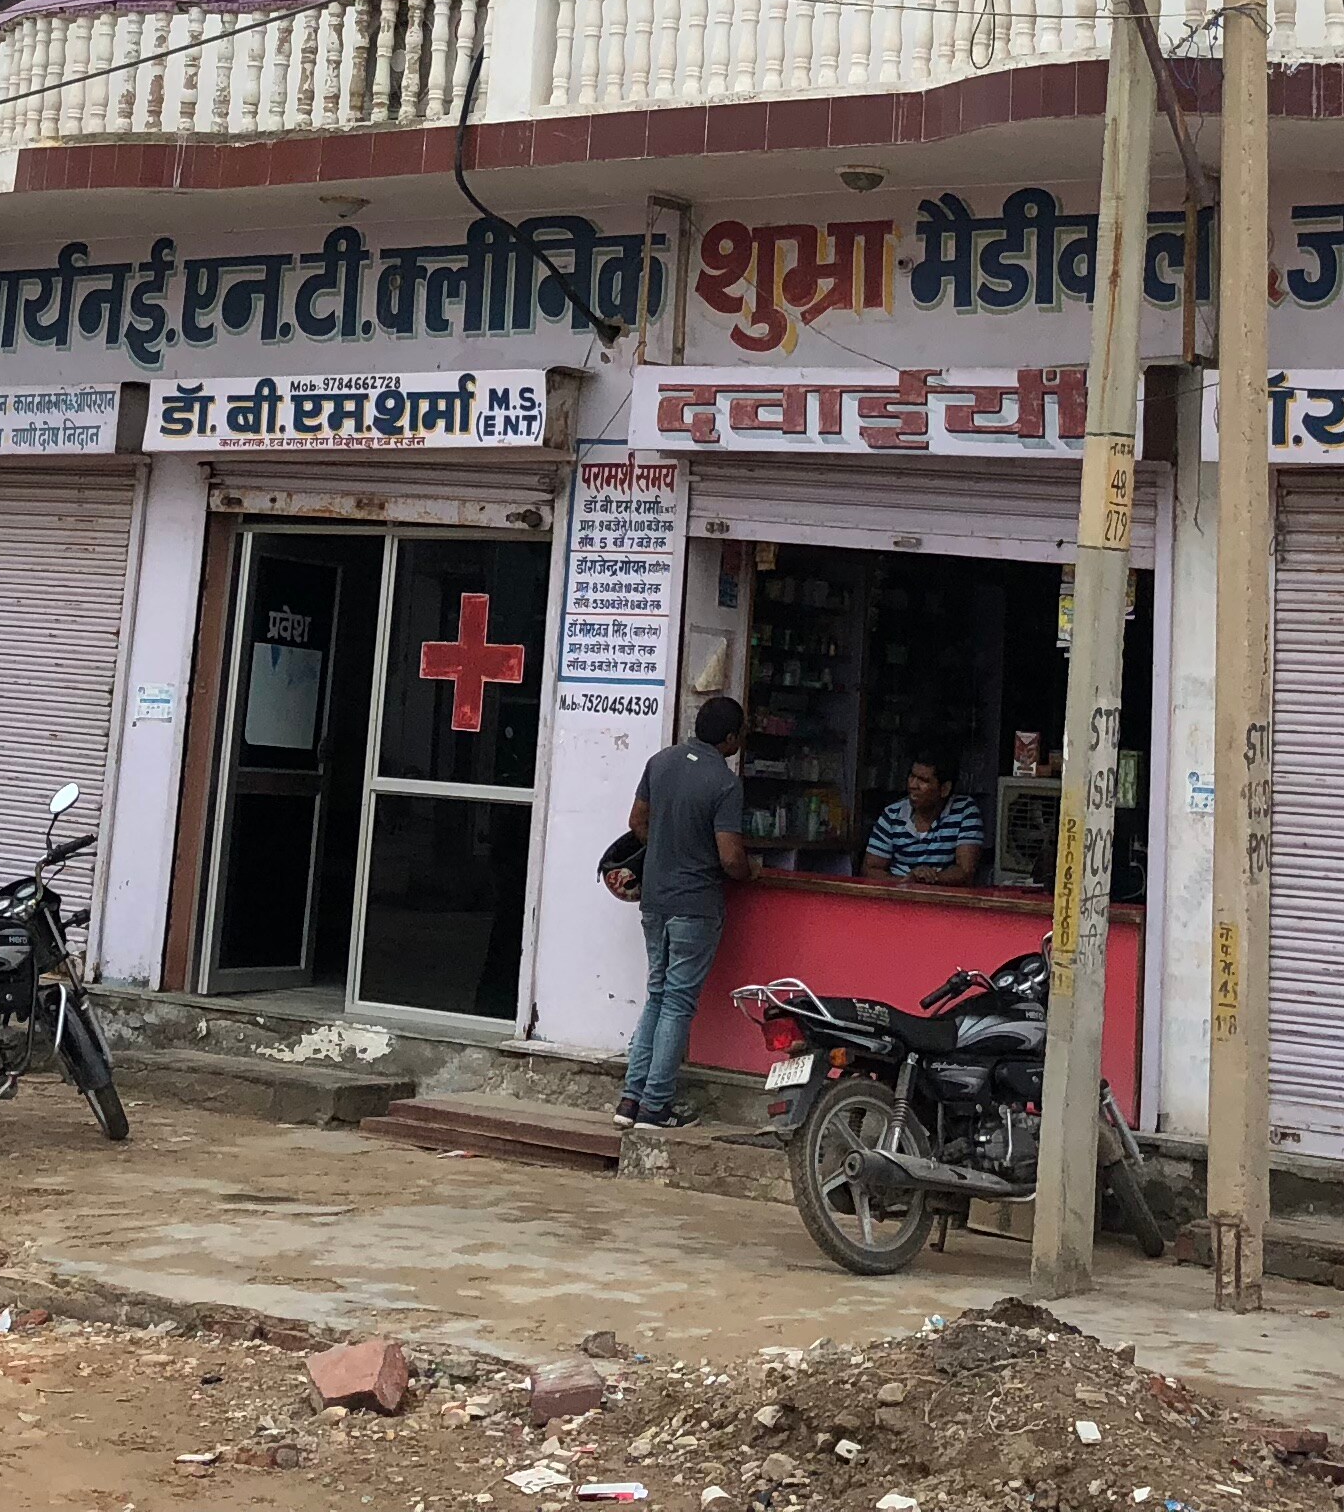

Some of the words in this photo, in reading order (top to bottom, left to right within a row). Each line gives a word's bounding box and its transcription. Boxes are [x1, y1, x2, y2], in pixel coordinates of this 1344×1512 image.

[695, 220, 894, 352] शुभ्रा
[488, 387, 542, 412] M.S.
[12, 421, 38, 448] वाणी
[39, 420, 61, 452] दोष
[63, 418, 102, 451] निदान
[476, 409, 543, 442] (E.N.T.)
[581, 452, 635, 495] परामर्श
[635, 464, 678, 494] समय
[1111, 469, 1127, 499] 48
[1105, 510, 1128, 542] 279
[599, 537, 607, 549] 5
[628, 537, 635, 549] 7
[269, 605, 312, 643] प्रवेश
[1083, 827, 1113, 879] PCO
